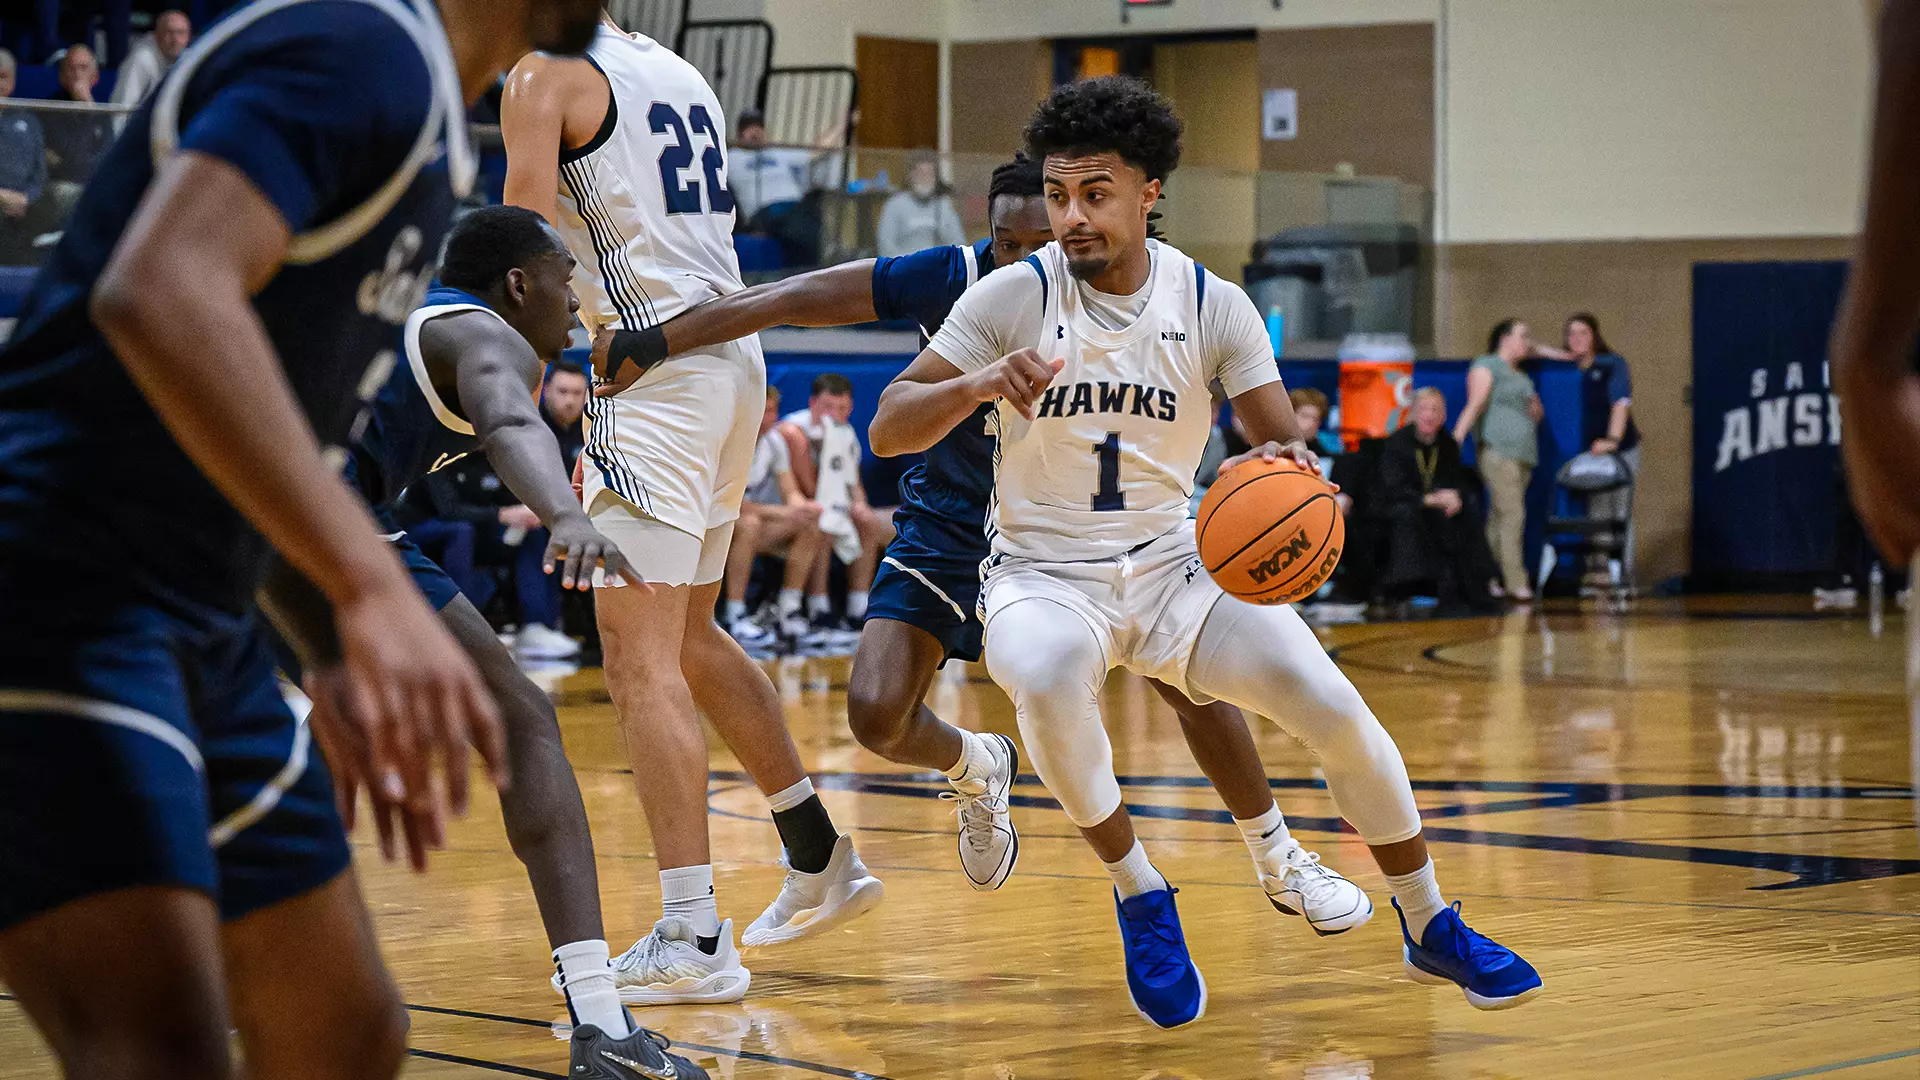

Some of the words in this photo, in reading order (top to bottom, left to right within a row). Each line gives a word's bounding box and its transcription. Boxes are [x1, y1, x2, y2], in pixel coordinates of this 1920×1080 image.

[645, 101, 735, 216] 22
[1161, 332, 1186, 342] NE10
[1036, 381, 1177, 422] HAWKS
[1090, 431, 1127, 511] 1
[1248, 529, 1311, 585] NCAA
